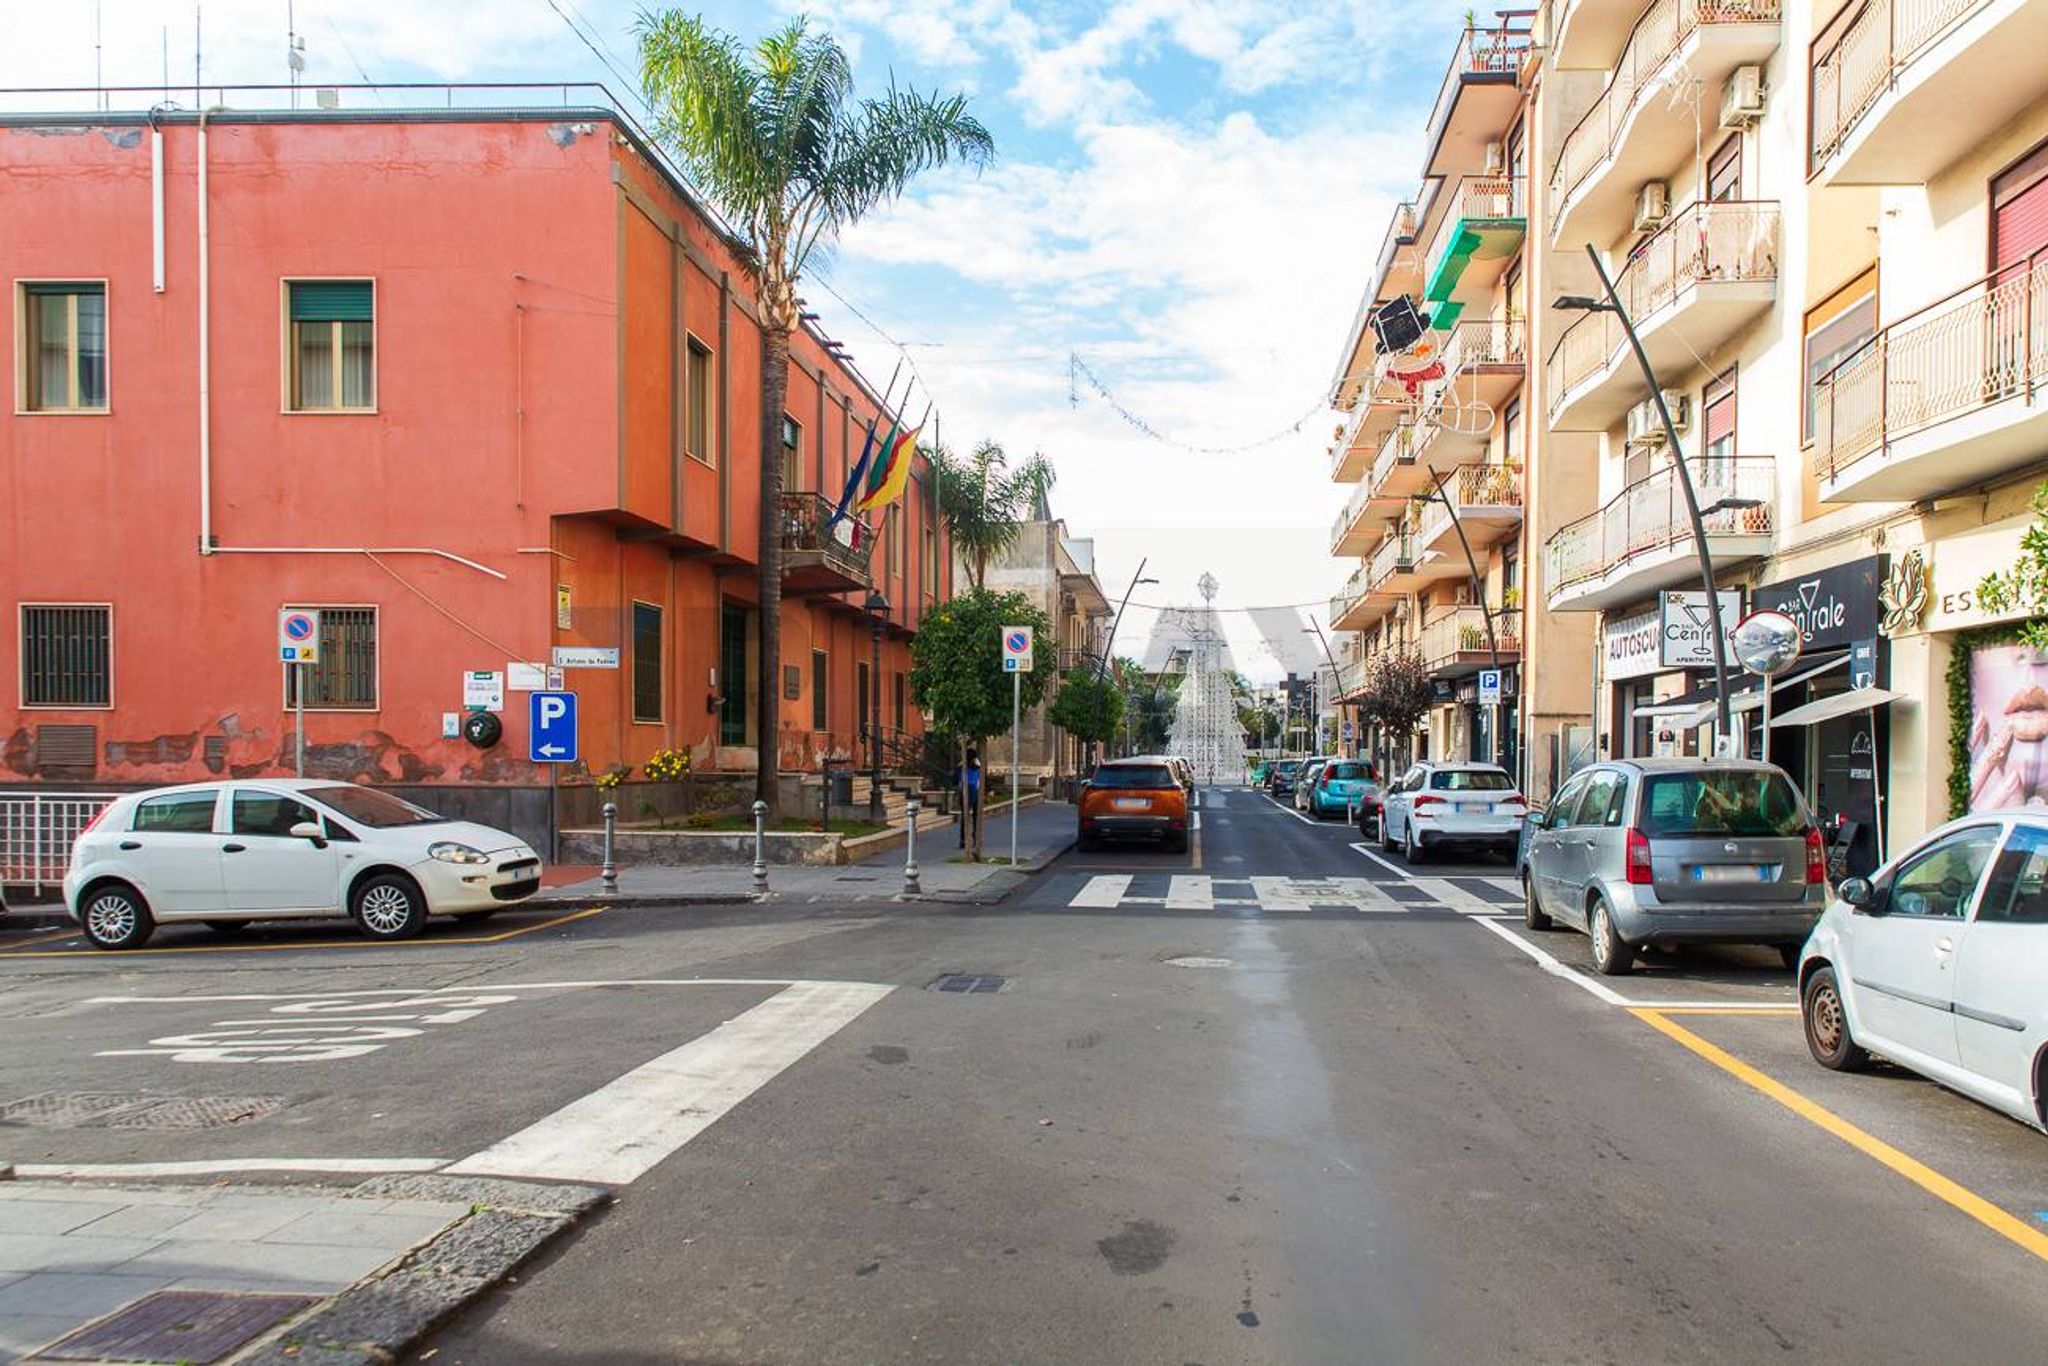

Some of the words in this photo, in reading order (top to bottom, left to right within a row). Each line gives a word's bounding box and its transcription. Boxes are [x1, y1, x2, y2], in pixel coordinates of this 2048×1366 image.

[1609, 625, 1660, 661] AUTOSCU
[1486, 675, 1495, 686] P
[541, 696, 566, 730] P
